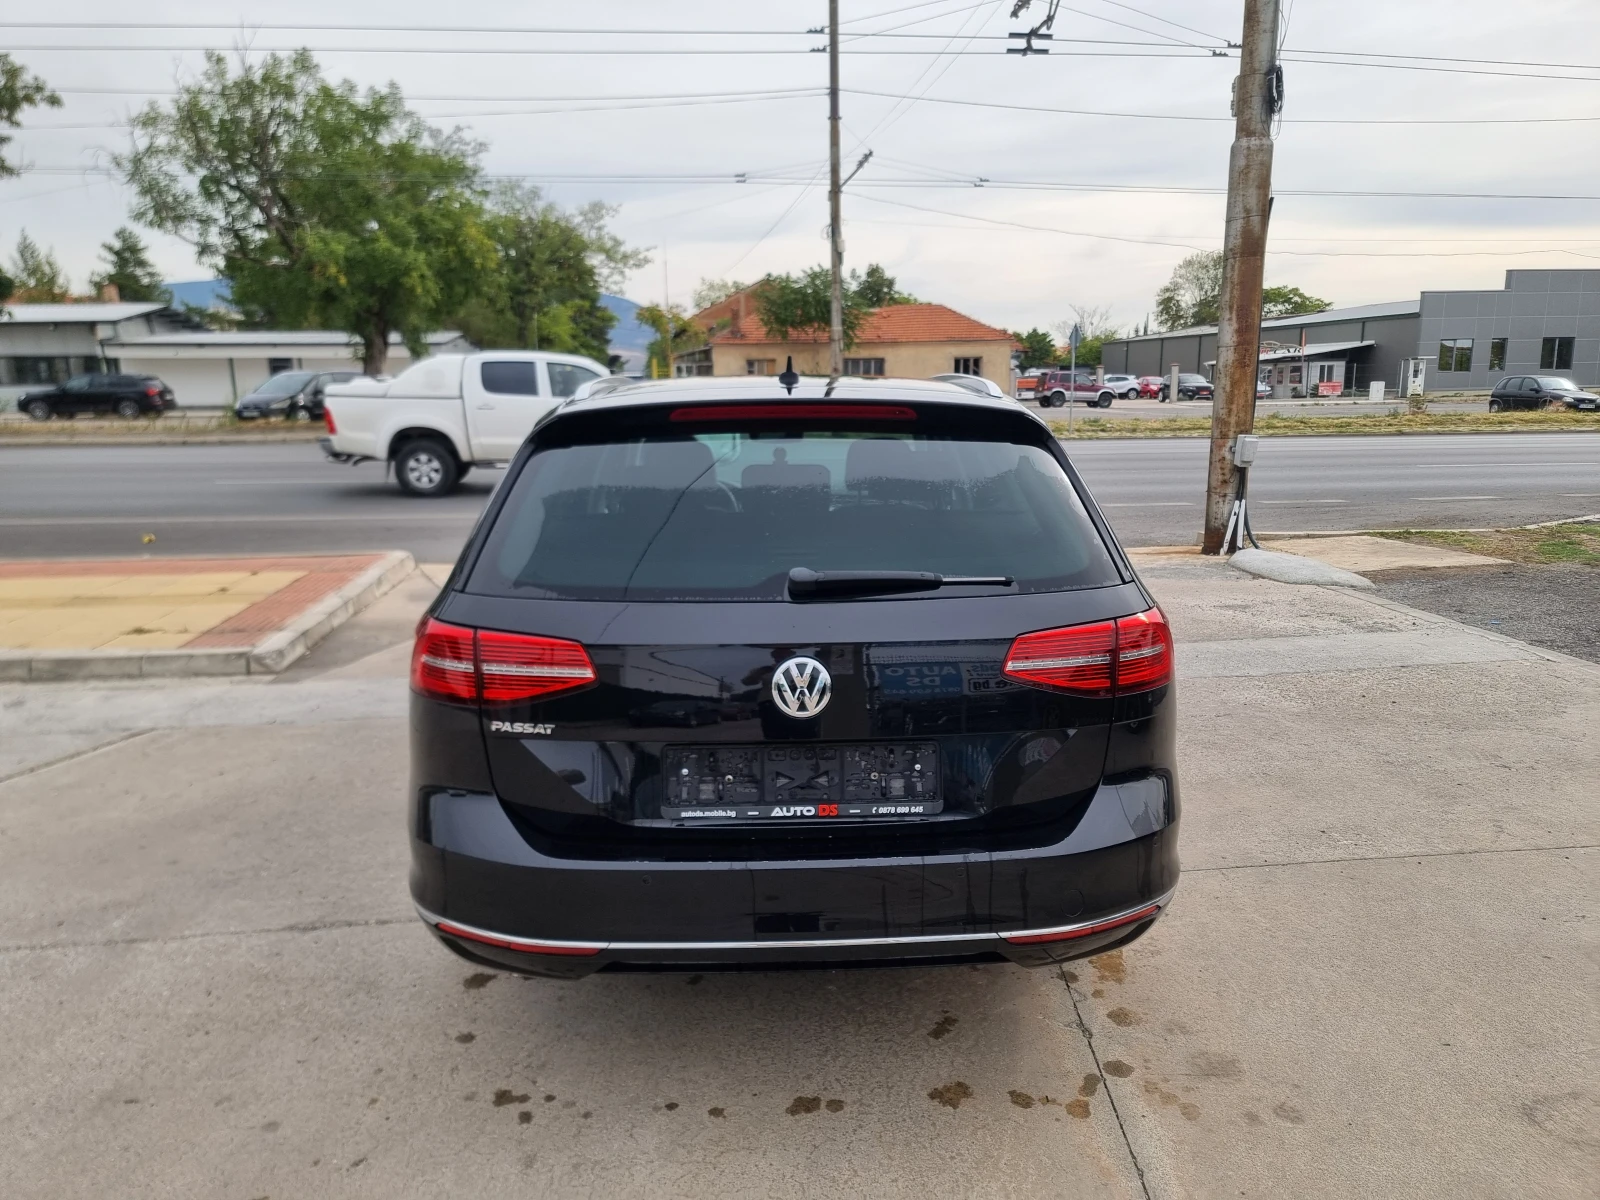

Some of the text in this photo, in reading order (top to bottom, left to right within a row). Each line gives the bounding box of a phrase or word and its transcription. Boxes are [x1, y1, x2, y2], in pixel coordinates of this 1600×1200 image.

[490, 721, 556, 735] PASSAT
[770, 803, 839, 817] AUTO DS
